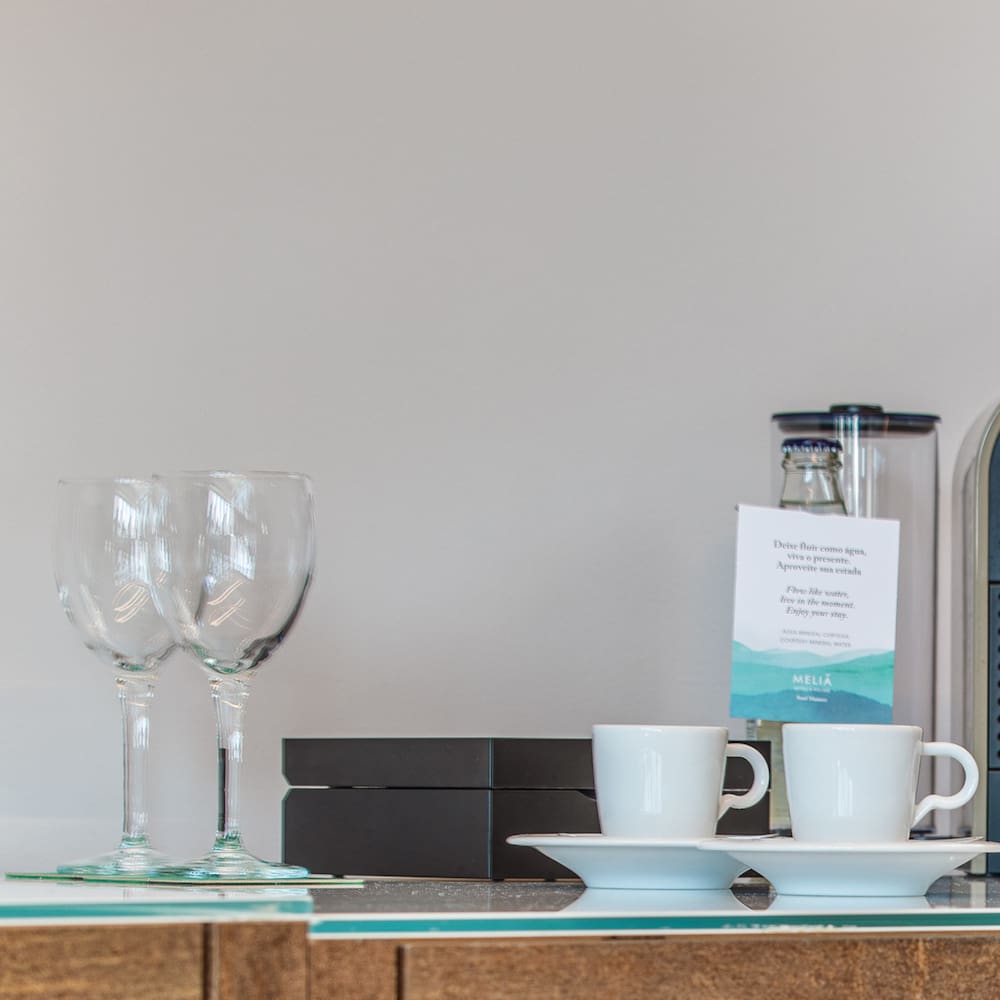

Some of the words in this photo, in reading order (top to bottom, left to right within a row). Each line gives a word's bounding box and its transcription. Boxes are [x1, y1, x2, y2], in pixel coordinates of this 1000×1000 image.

[773, 539, 798, 550] Deixe
[820, 545, 844, 554] como
[787, 552, 805, 561] viva
[776, 560, 818, 573] Aproveite
[786, 606, 809, 618] Enjoy
[811, 610, 829, 619] your
